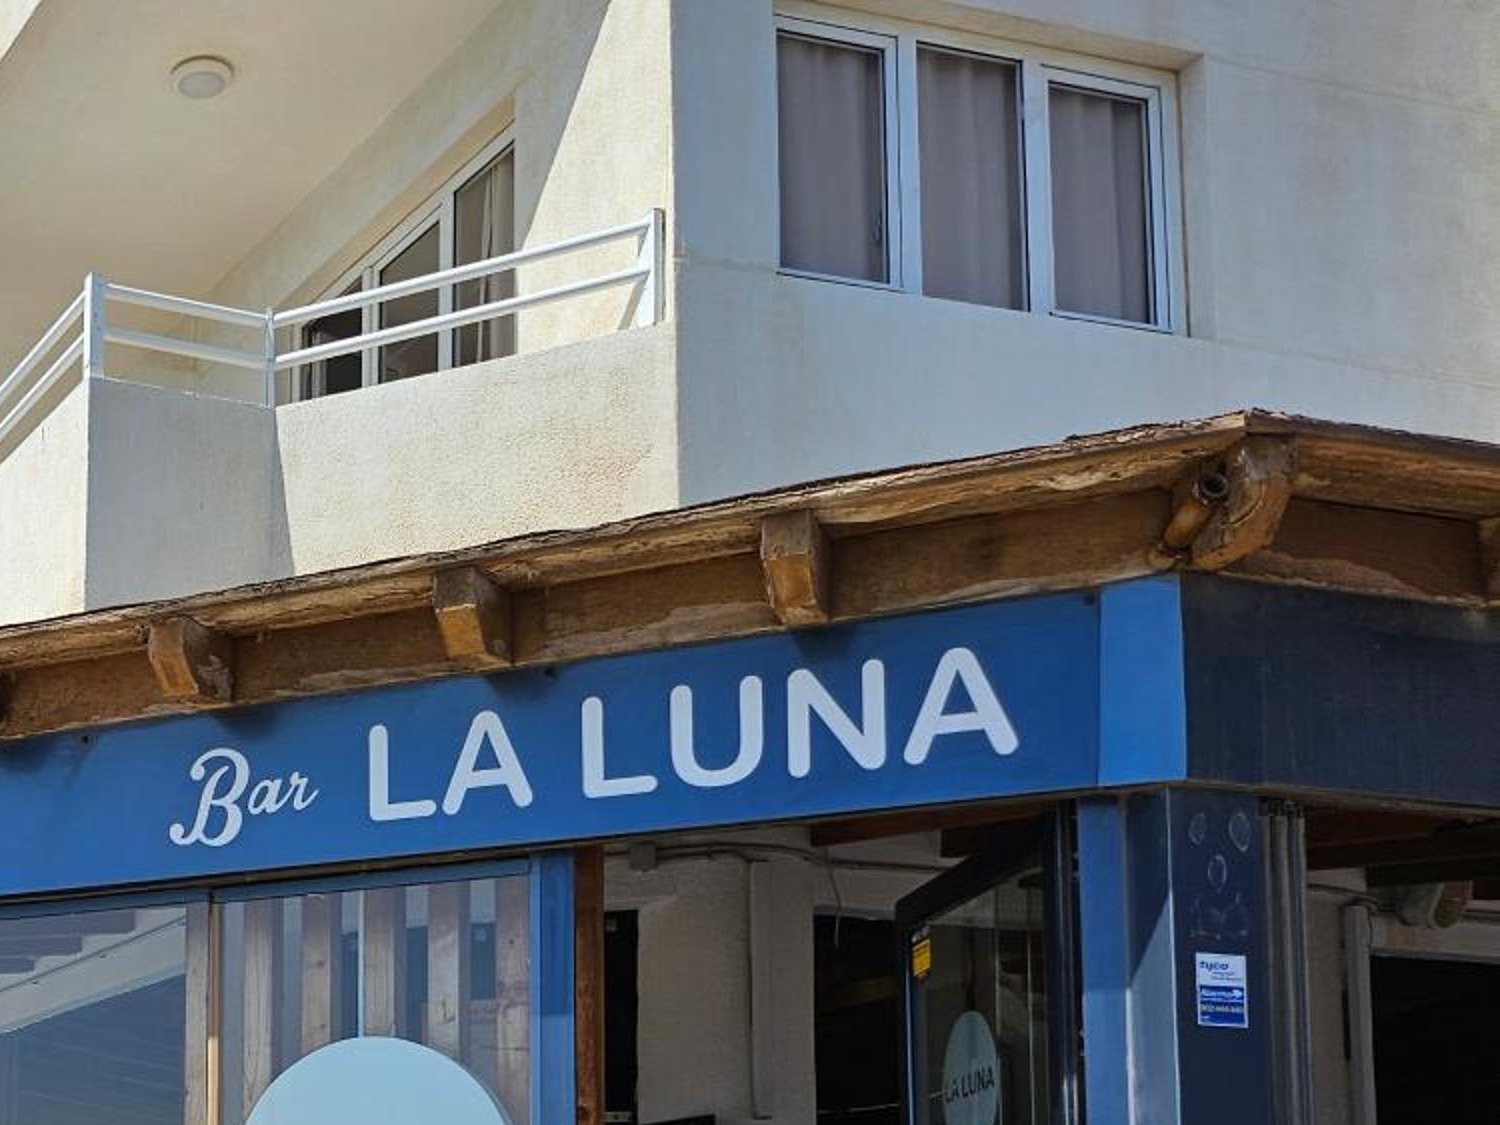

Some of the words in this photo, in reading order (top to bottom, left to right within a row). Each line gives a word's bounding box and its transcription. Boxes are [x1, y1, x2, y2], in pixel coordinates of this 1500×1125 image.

[169, 747, 320, 847] Bar
[367, 710, 535, 822] LA
[580, 647, 1021, 800] LUNA
[961, 1066, 995, 1098] LUNA
